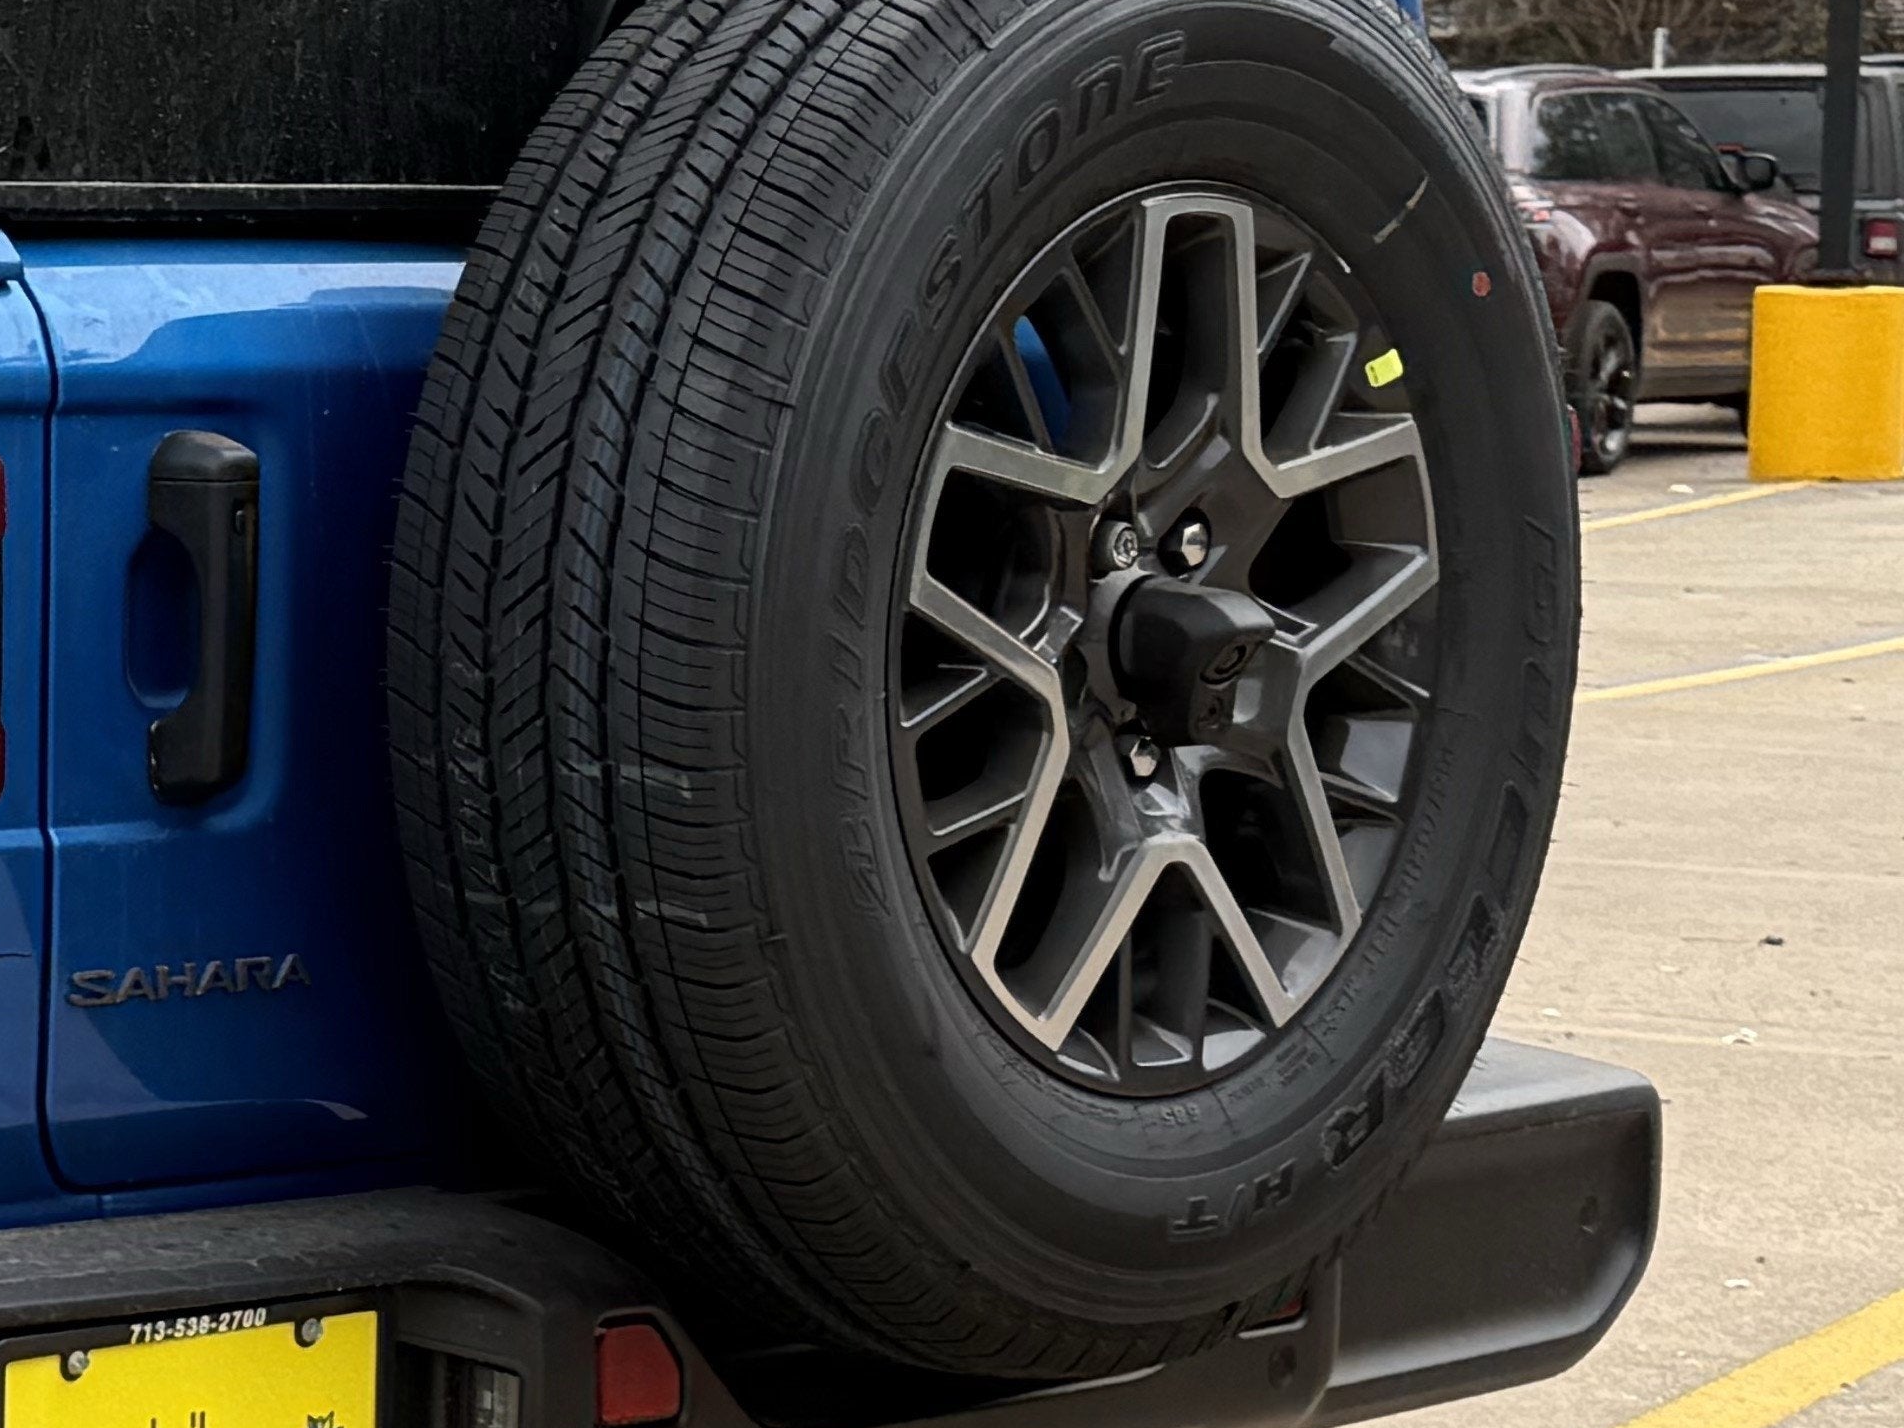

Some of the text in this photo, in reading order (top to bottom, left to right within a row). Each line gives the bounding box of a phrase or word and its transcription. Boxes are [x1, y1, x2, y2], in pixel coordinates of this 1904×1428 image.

[824, 28, 1188, 924] BRIDGESTONE
[67, 952, 313, 1008] SAHARA
[1166, 1158, 1297, 1240] H/T
[128, 1306, 267, 1345] 713-538-2700
